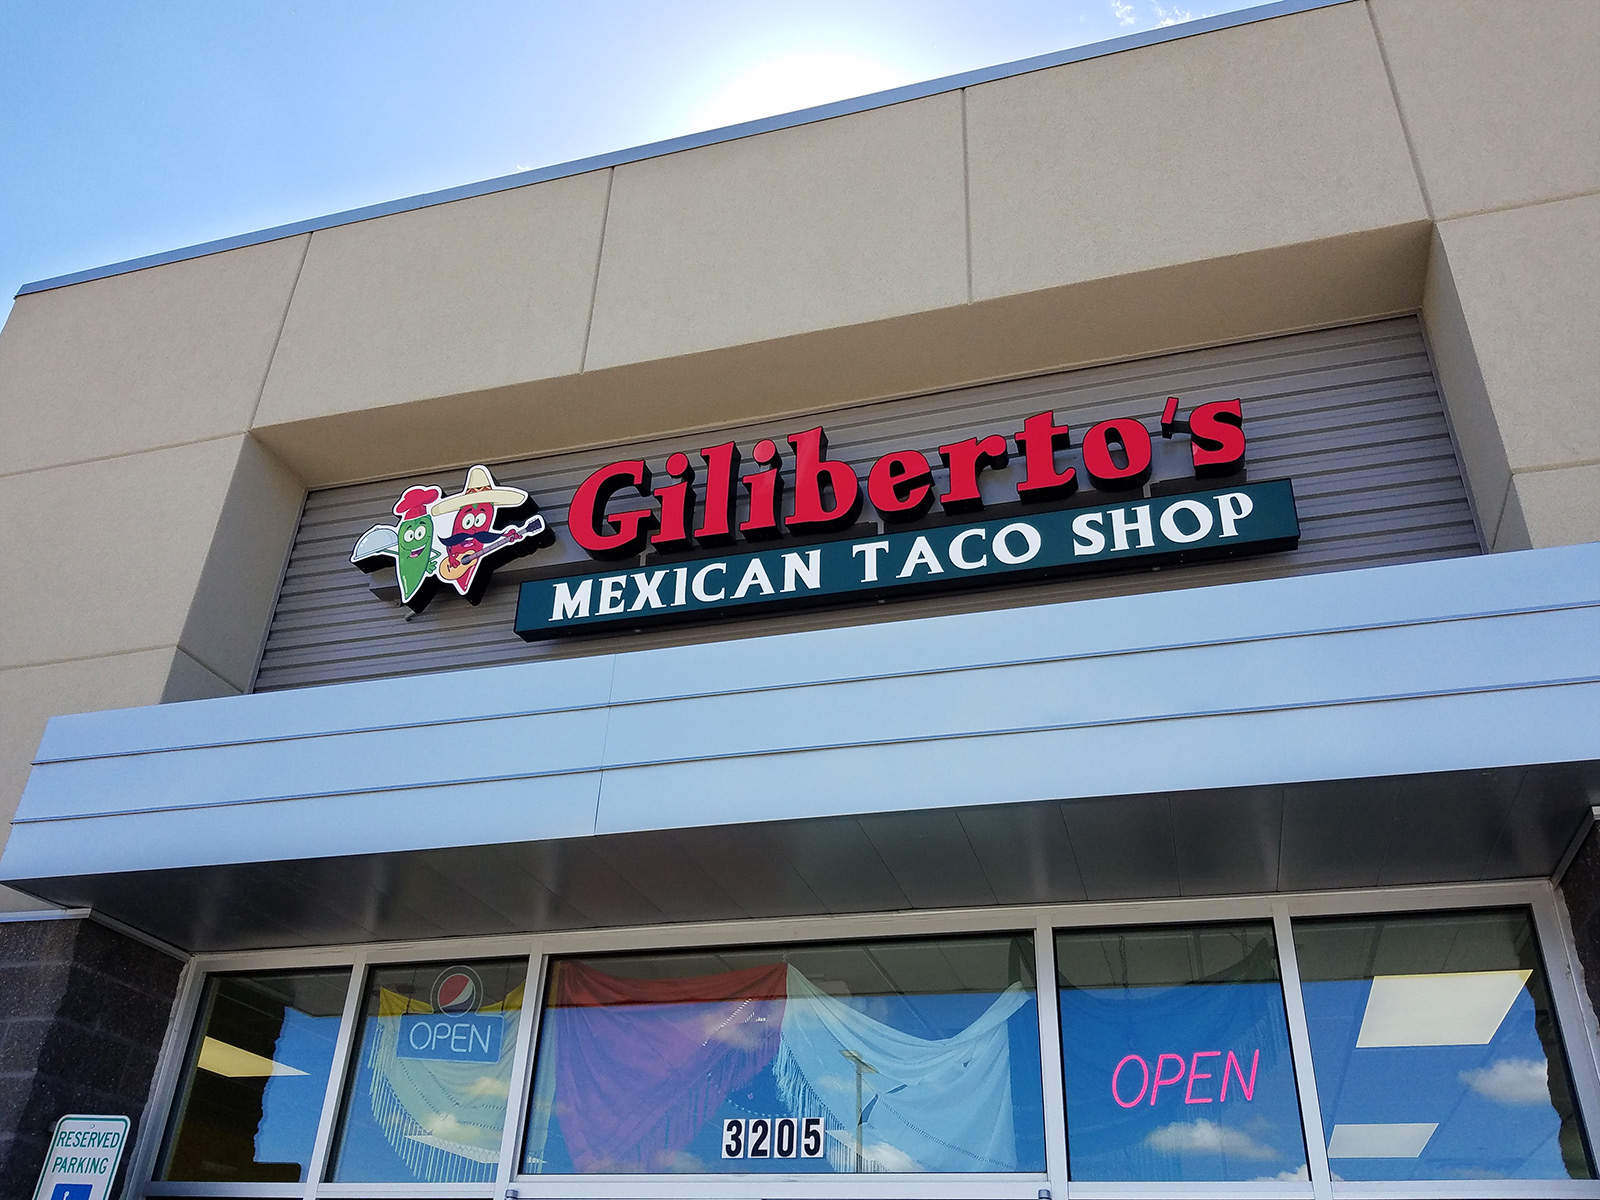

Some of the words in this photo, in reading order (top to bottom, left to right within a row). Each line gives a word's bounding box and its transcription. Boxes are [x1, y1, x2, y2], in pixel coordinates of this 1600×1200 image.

[568, 397, 1246, 552] Giliberto's
[548, 550, 822, 622] MEXICAN
[852, 522, 1042, 583] TACO
[1072, 491, 1254, 557] SHOP
[410, 1022, 491, 1054] OPEN
[1111, 1048, 1260, 1109] OPEN
[57, 1131, 120, 1149] RESERVED
[725, 1118, 822, 1158] 3205
[53, 1156, 109, 1175] PARKING
